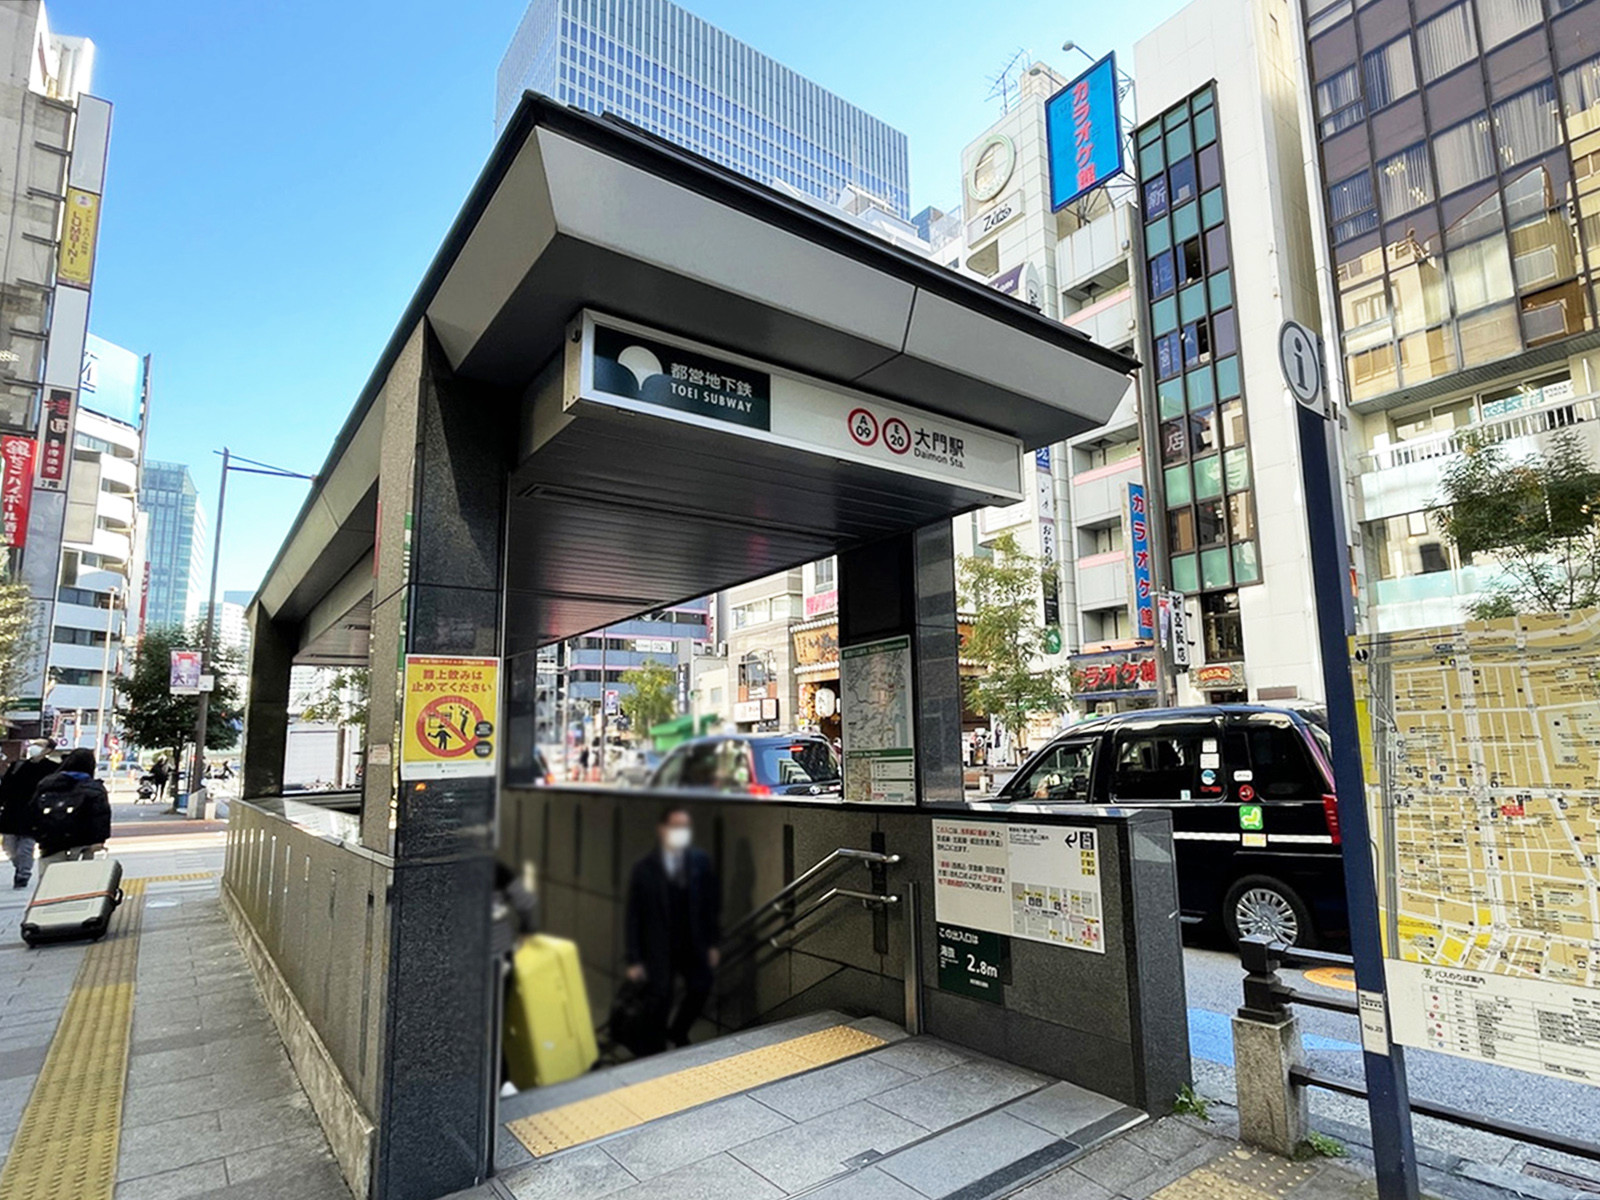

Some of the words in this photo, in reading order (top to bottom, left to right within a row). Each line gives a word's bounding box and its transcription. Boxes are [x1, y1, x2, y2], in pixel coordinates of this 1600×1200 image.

[1071, 79, 1097, 192] カラオケ館
[670, 361, 753, 399] 都営地下鉄
[670, 382, 699, 401] TOEI
[703, 393, 753, 414] SUBWAY
[855, 424, 872, 439] 09
[859, 415, 868, 427] A
[893, 424, 900, 435] E
[890, 434, 905, 448] 20
[914, 427, 965, 459] 大門駅
[914, 446, 949, 465] Daimon
[949, 454, 966, 470] Sta.
[1132, 493, 1153, 628] カラオケ館
[411, 681, 493, 693] 止めてください
[966, 953, 998, 978] 2.8m
